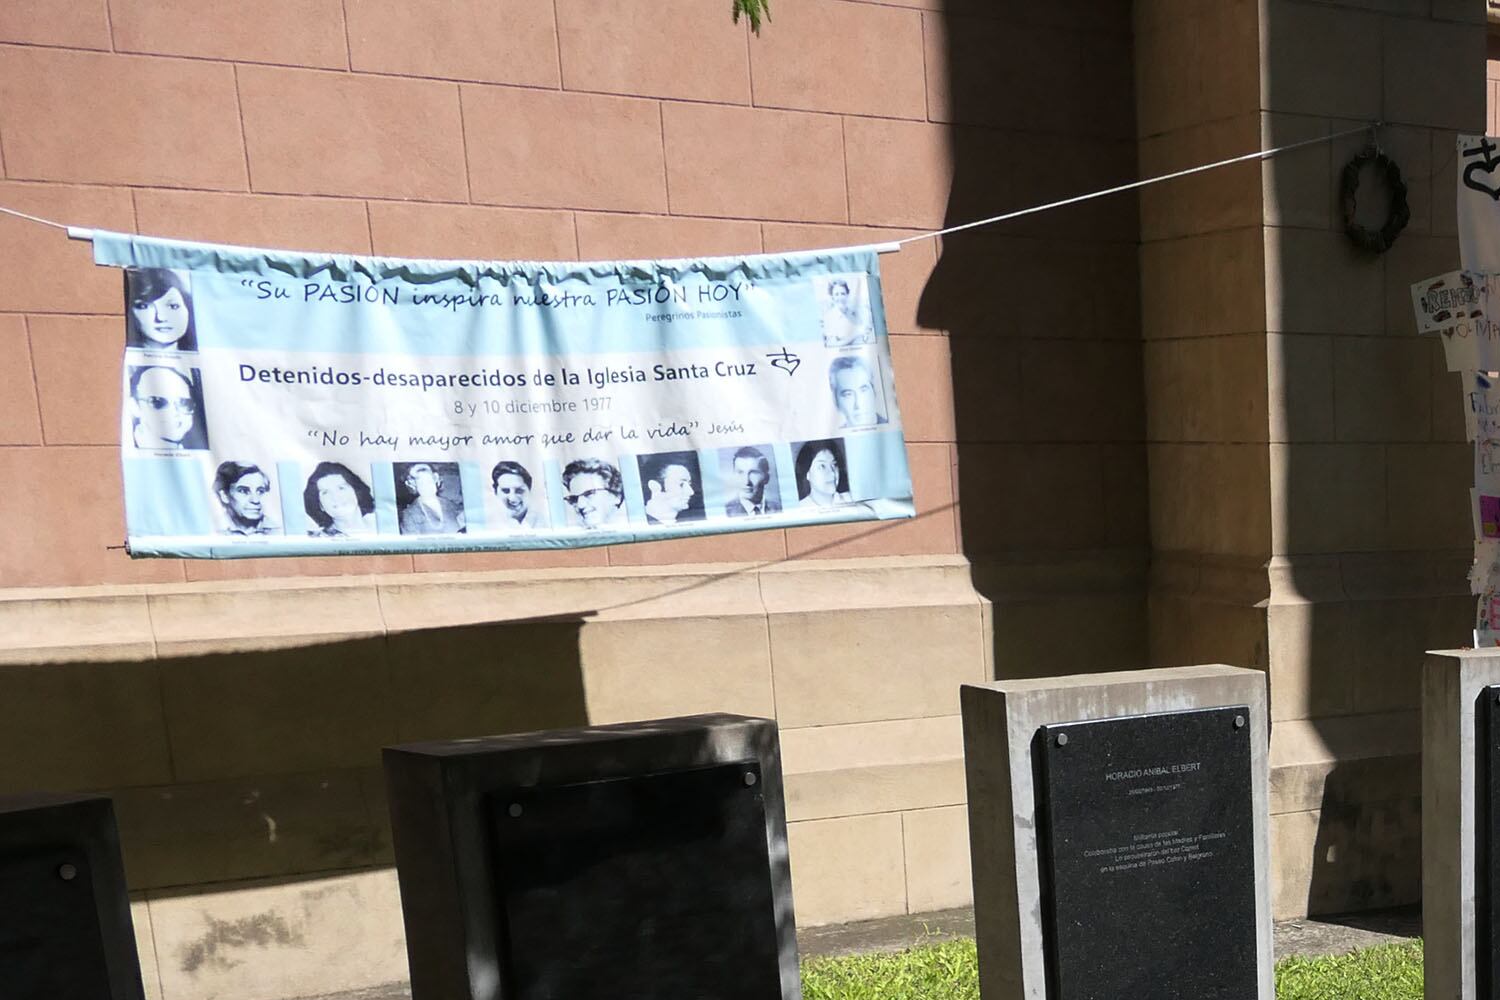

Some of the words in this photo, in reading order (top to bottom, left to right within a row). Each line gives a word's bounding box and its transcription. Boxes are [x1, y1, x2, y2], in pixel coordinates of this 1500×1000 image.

[413, 287, 502, 312] inspira
[513, 288, 596, 308] nuestra
[645, 310, 695, 323] Peregrinos
[239, 363, 527, 393] Detenidos-desaparecidos
[532, 367, 555, 387] de
[562, 367, 580, 386] la
[588, 364, 647, 390] Iglesia
[653, 362, 709, 382] Santa
[715, 360, 757, 379] Cruz
[454, 402, 463, 414] 8
[467, 404, 477, 417] y
[484, 400, 500, 414] 10
[505, 398, 577, 414] diciembre
[583, 396, 612, 412] 1977
[359, 430, 399, 451] hay
[409, 434, 473, 451] mayor
[482, 432, 535, 446] amor
[541, 431, 575, 449] que
[583, 425, 613, 442] dar
[620, 425, 638, 440] la
[708, 421, 744, 435] Jesús
[1105, 769, 1142, 781] HORACIO
[1143, 766, 1171, 777] ANIBAL
[1172, 762, 1201, 773] ELBERT
